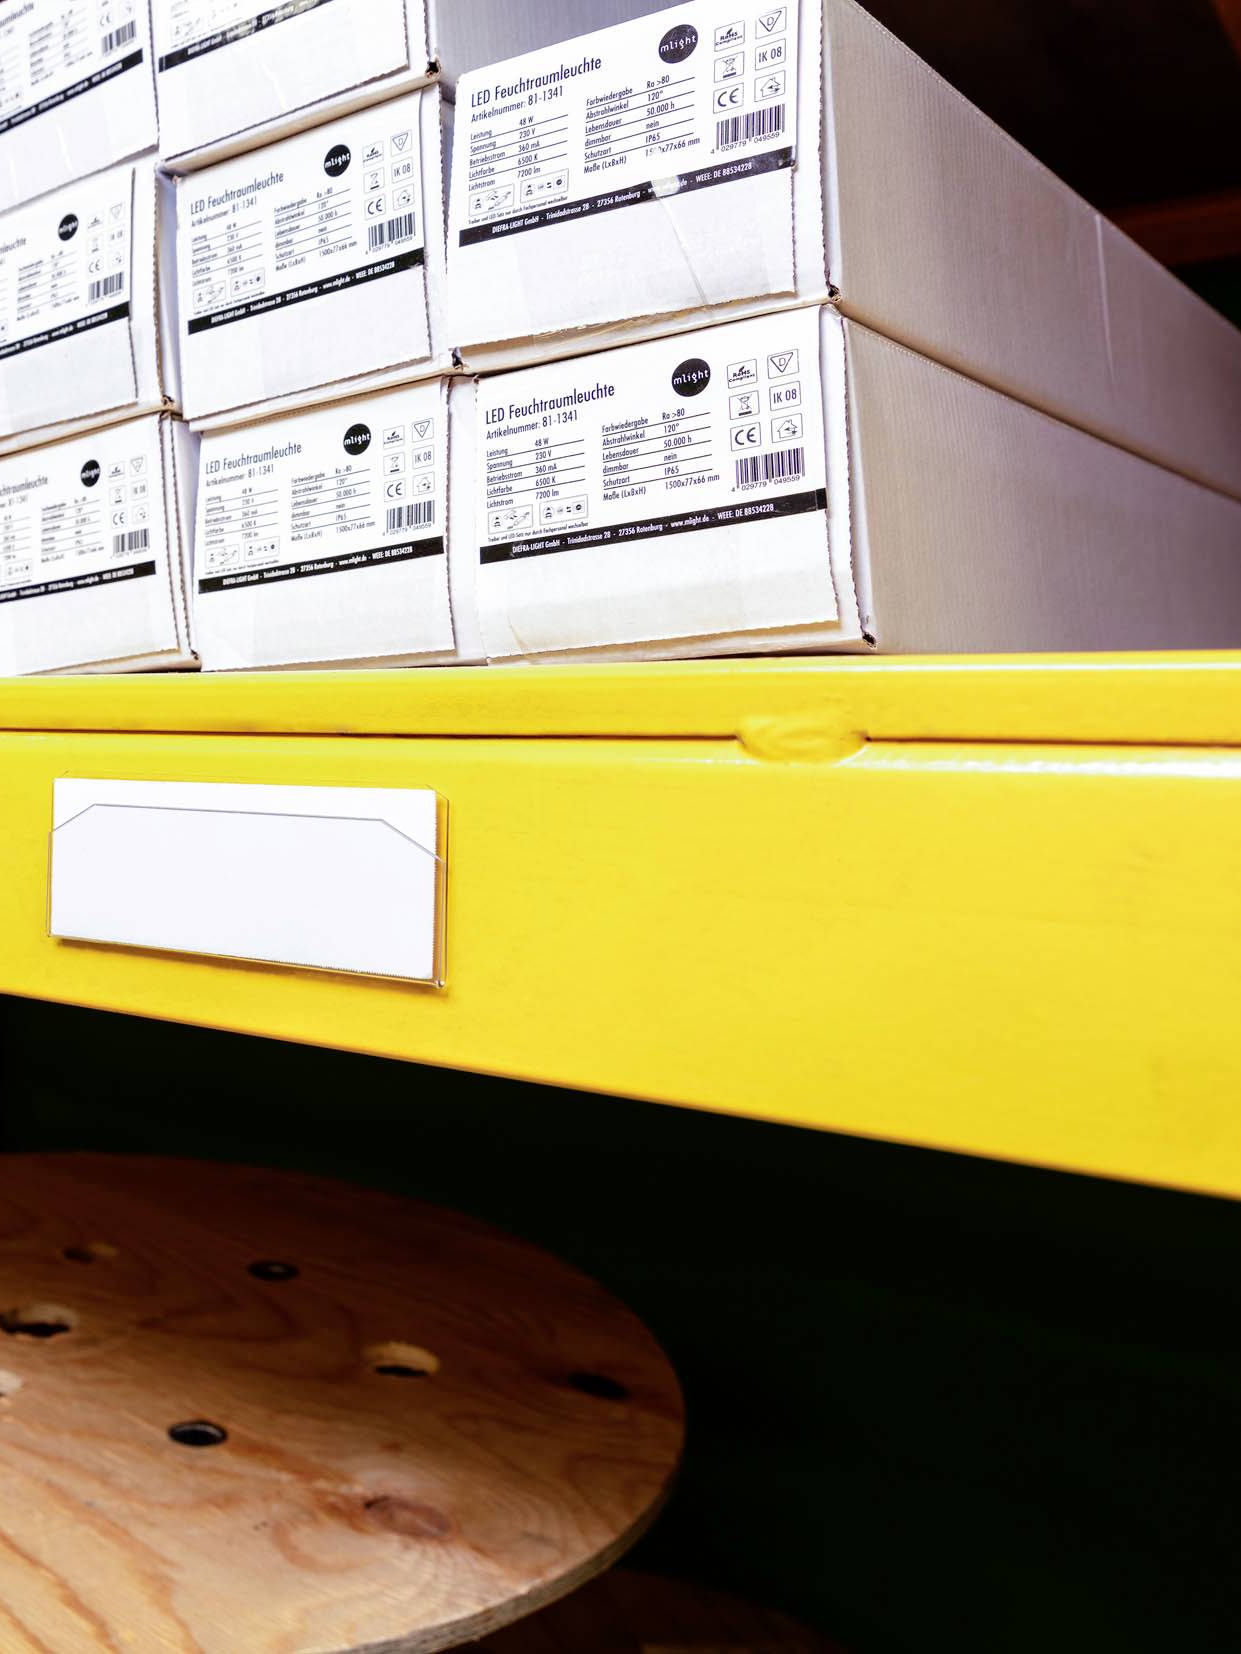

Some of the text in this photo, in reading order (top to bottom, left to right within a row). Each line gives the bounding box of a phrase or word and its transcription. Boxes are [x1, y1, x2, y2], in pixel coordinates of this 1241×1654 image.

[766, 16, 774, 26] D
[660, 34, 696, 53] mlight
[758, 46, 782, 63] IK 08
[471, 56, 601, 108] LED Feuchtraumleuchte
[586, 74, 670, 106] Farbwiedergabe Ra >80
[471, 85, 563, 123] Artikelnummer: 81-1341
[585, 89, 663, 120] Abstrahlwinkel 120°
[470, 129, 492, 141] Leistung
[519, 117, 526, 126] 48
[585, 100, 675, 134] Lebensdauer 50.000 h
[469, 127, 535, 153] Spannung 230 V
[584, 119, 659, 147] dimmbar nein
[720, 140, 747, 152] 029779
[753, 131, 780, 144] 049559
[469, 140, 540, 166] Betriebsstrom 360 mA
[583, 137, 700, 174] Maße (LxBxH) 15x77x66 mm
[584, 132, 660, 160] Schutzart IP65
[324, 151, 351, 171] mlight
[393, 162, 411, 177] IK 08
[468, 166, 495, 179] Lichtfarbe
[517, 154, 533, 166] 6500
[695, 161, 752, 183] WEEE: DE 88534228
[468, 166, 541, 192] Lichtstrom 7200 lm
[190, 171, 284, 215] LED Feuchtraumleuchte
[524, 215, 539, 225] GmbH
[545, 206, 581, 220] Trinidadstrasse
[582, 202, 590, 211] 28
[596, 196, 614, 207] 27356
[614, 190, 641, 203] Rotenburg
[778, 357, 786, 367] D
[673, 369, 708, 385] mlight
[485, 382, 615, 425] LED Feuchtraumleuchte
[773, 388, 797, 404] IK 08
[486, 409, 577, 440] Artikelnummer: 81-1341
[601, 407, 685, 433] Farbwiedergabe Ra >80
[343, 431, 371, 448] mlight
[602, 422, 680, 446] Abstrahlwinkel 120°
[205, 441, 302, 475] LED Feuchtraumleuchte
[414, 450, 432, 462] IK 08
[486, 437, 549, 458] Leistung 48 W
[602, 435, 692, 461] Lebensdauer 50.000 h
[486, 449, 552, 471] Spannung 230 V
[602, 452, 677, 474] dimmbar nein
[486, 463, 557, 484] Betriebsstrom 360 mA
[486, 475, 556, 496] Lichtfarbe 6500 K
[602, 465, 679, 488] Schutzart IP65
[741, 480, 767, 491] 029779
[773, 474, 800, 485] 049559
[486, 488, 559, 509] Lichtstrom 7200 lm
[602, 474, 720, 501] Maße (LxBxH) 1500x77x66 mm
[512, 503, 774, 553] DIEFRA-LIGHT GmbH Trinidadstrasse 28 27356 Rotenburg www.mlight.de WEEE: DE 88534228
